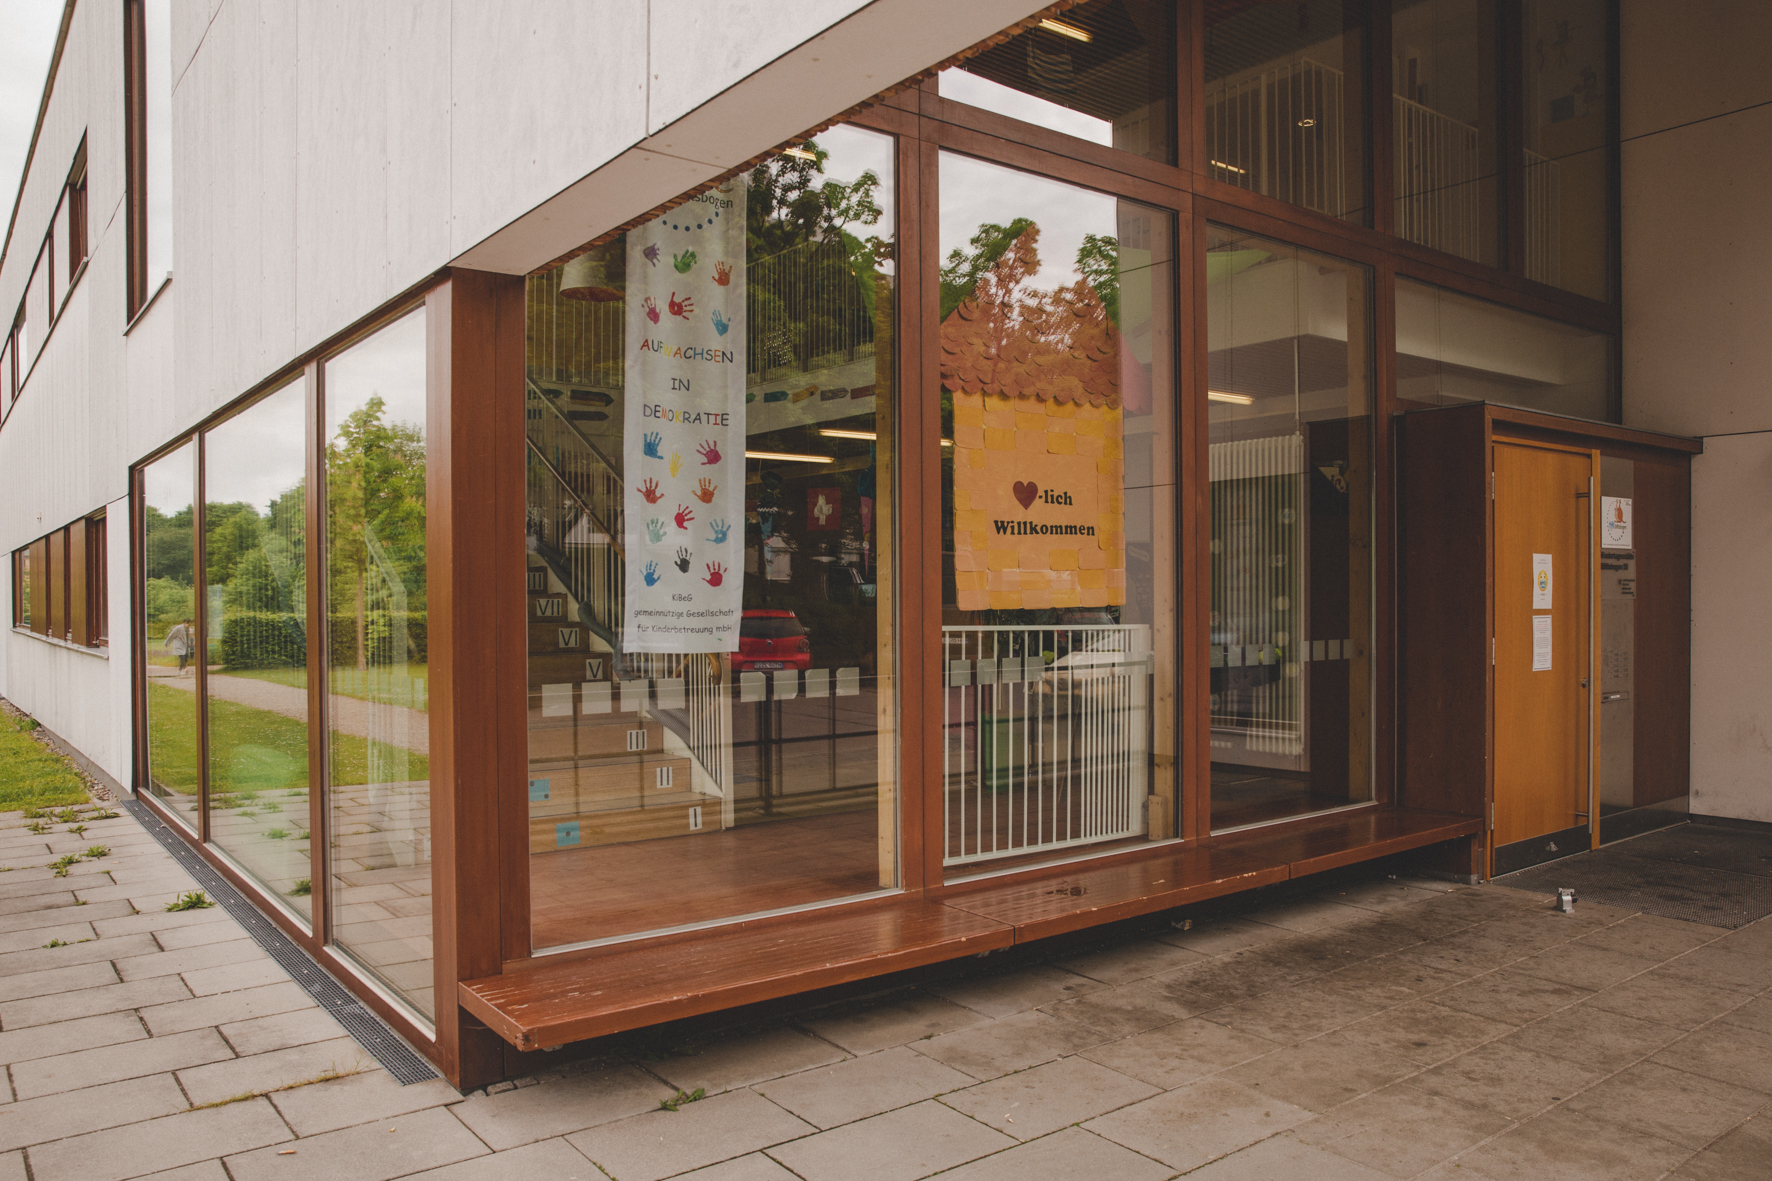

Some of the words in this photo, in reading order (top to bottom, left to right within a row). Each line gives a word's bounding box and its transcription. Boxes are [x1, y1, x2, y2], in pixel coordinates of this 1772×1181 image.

[640, 338, 734, 364] AUFWACHSEN
[671, 377, 690, 391] IN
[643, 403, 730, 427] DEMOKRATIE
[993, 520, 1096, 536] Willkommen
[672, 593, 693, 602] KiBeG
[536, 599, 560, 616] VII
[686, 608, 734, 618] Gesellschaft
[560, 629, 578, 647] VI
[637, 624, 650, 633] für
[651, 624, 714, 635] Kinderbetreuung
[715, 624, 732, 632] mbH
[588, 661, 602, 679] V
[629, 731, 646, 750] III
[659, 768, 670, 787] II
